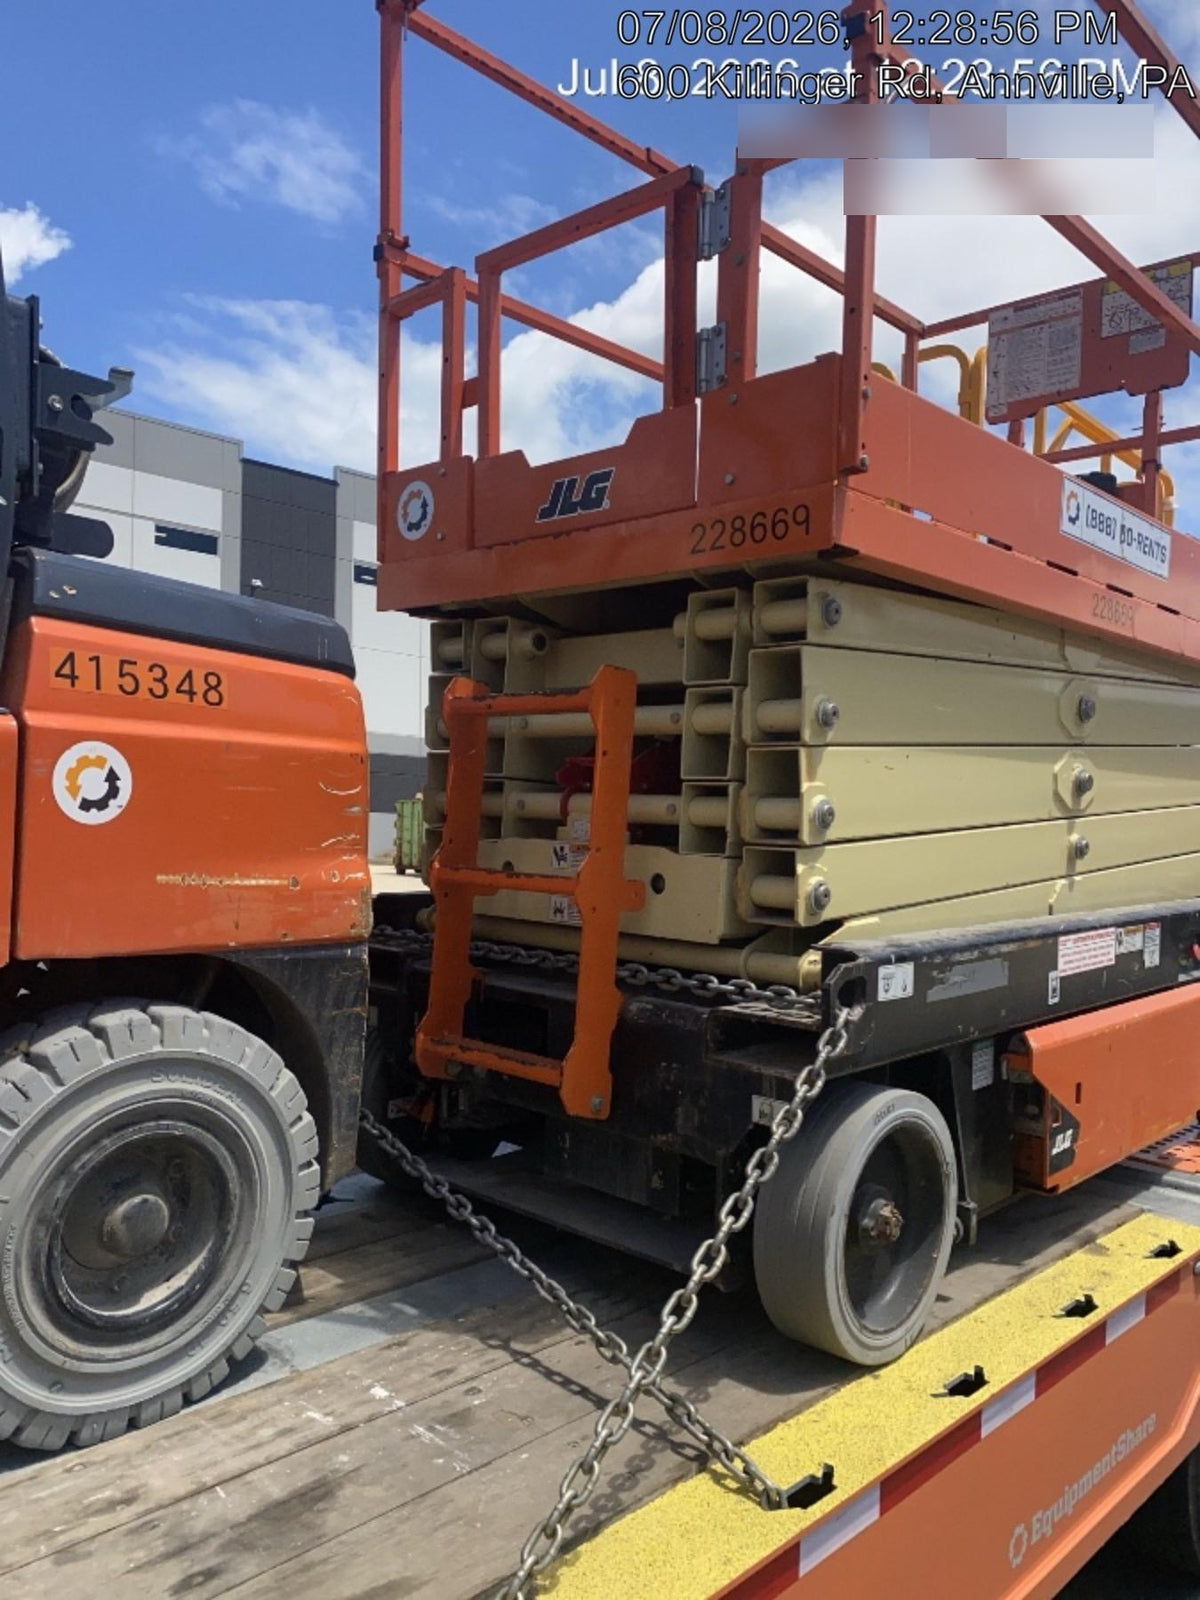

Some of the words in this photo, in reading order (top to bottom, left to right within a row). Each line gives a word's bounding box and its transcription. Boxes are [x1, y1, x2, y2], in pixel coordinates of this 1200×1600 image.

[535, 467, 616, 523] JLG
[690, 503, 811, 556] 228669
[53, 651, 225, 707] 415348
[1031, 1412, 1157, 1545] EquipmentShare
